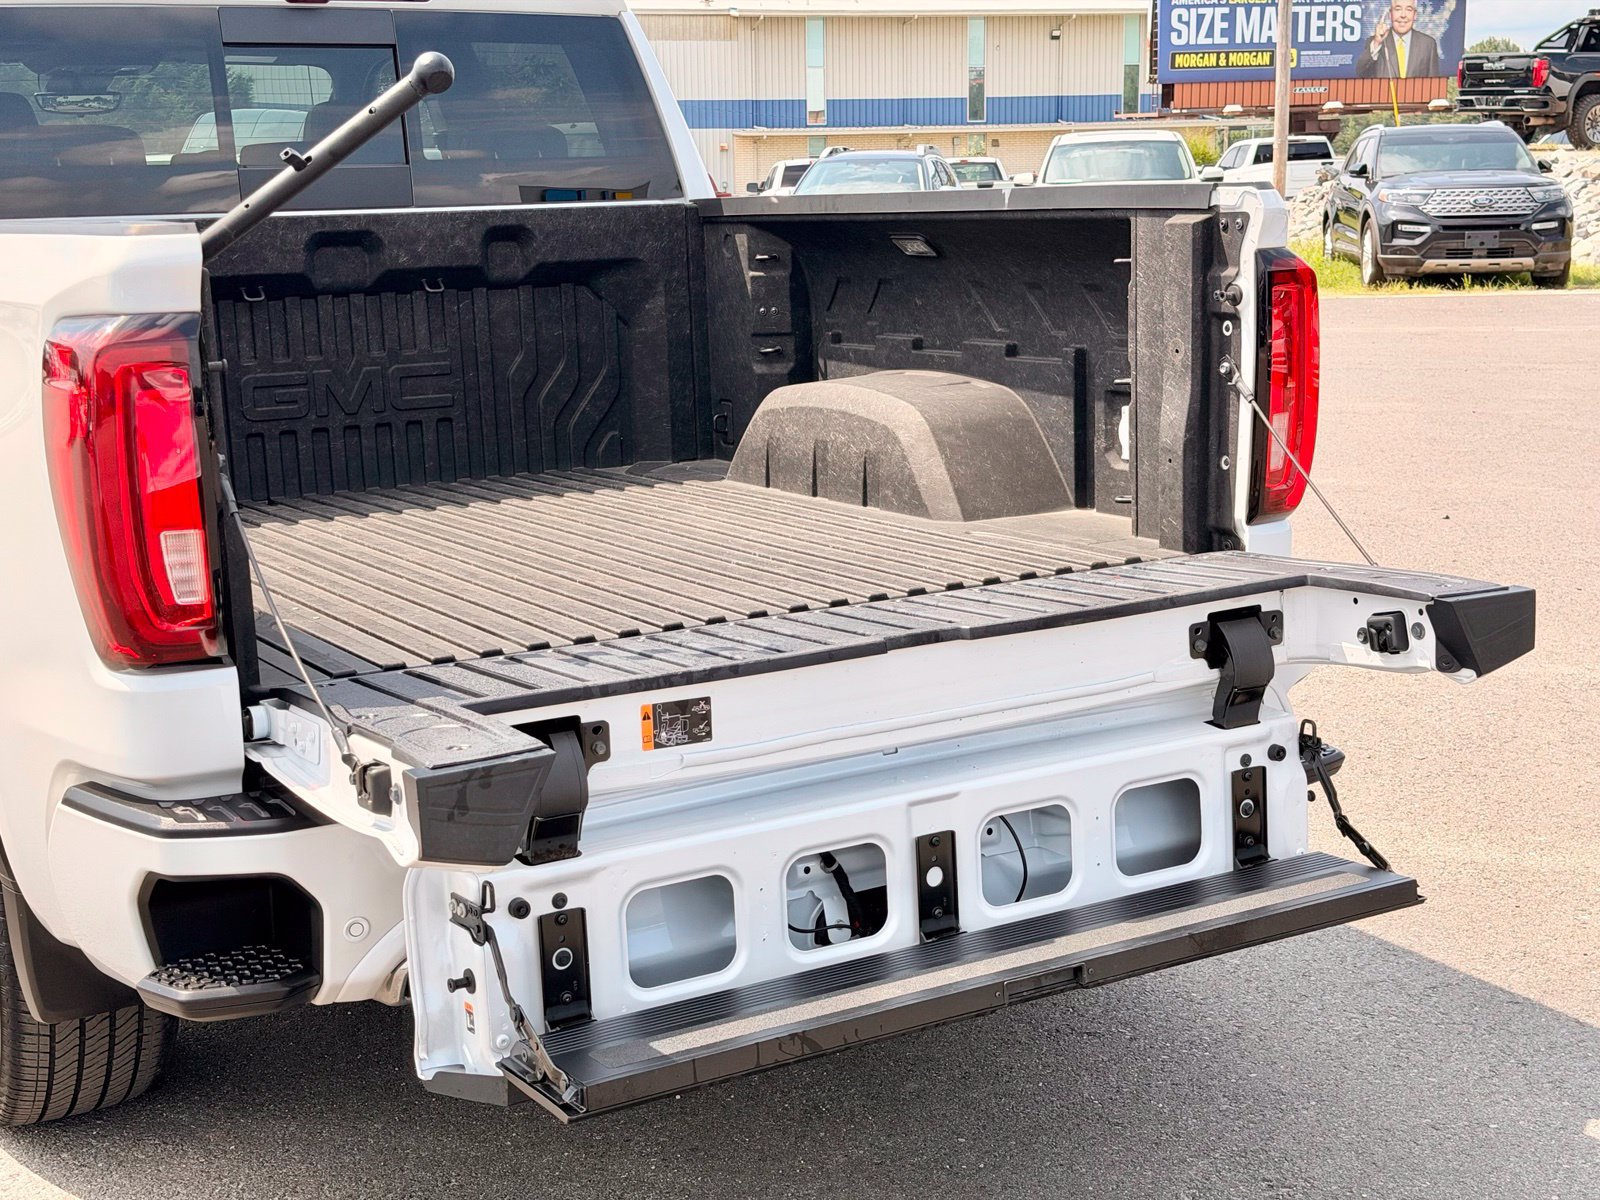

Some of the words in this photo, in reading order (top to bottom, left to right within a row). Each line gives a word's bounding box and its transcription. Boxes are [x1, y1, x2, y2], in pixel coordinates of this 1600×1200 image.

[1171, 7, 1230, 46] SIZE
[1235, 5, 1362, 44] MATERS
[1174, 53, 1217, 68] MORGAN
[1218, 52, 1227, 67] &
[1228, 51, 1271, 66] MORGAN
[241, 361, 453, 422] GMC
